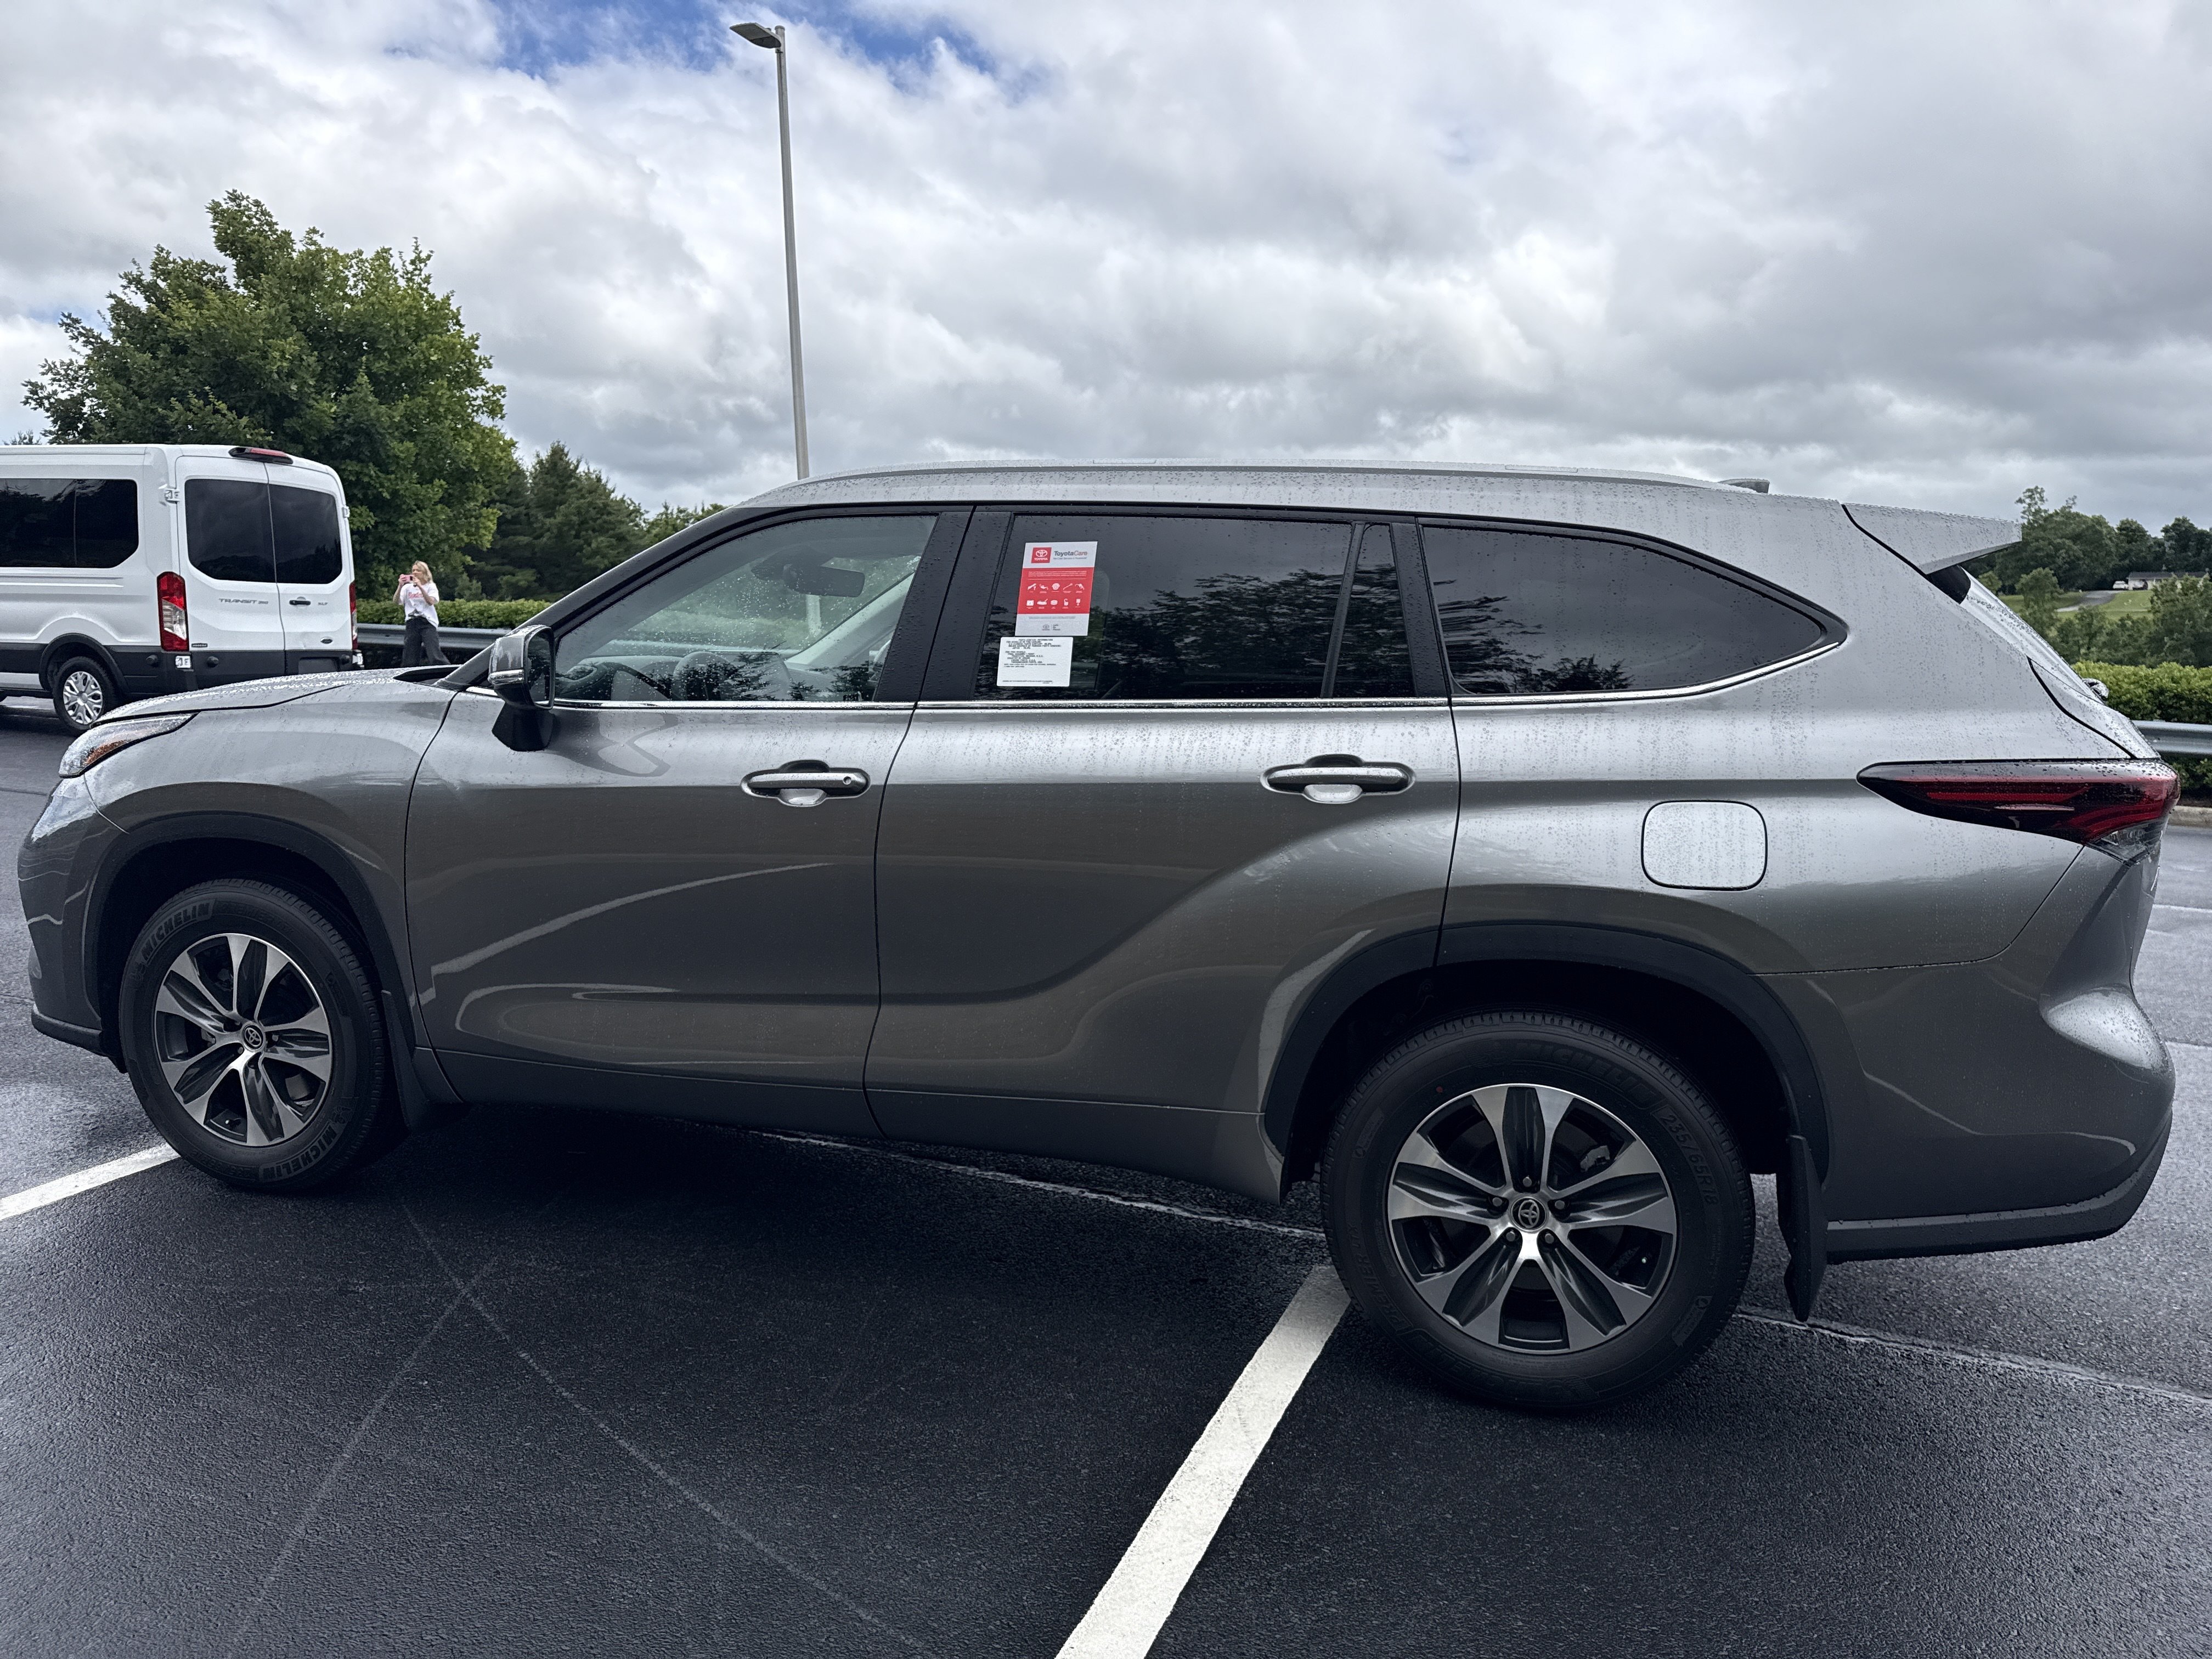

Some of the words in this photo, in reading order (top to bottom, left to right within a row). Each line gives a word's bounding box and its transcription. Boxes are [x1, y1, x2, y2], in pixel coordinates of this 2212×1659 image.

[140, 902, 211, 962] MICHELIN
[1516, 1042, 1658, 1103] MICHELIN
[262, 1127, 337, 1180] MICHELIN
[1658, 1113, 1719, 1205] 235/65R18
[1359, 1255, 1407, 1332] PREMIER
